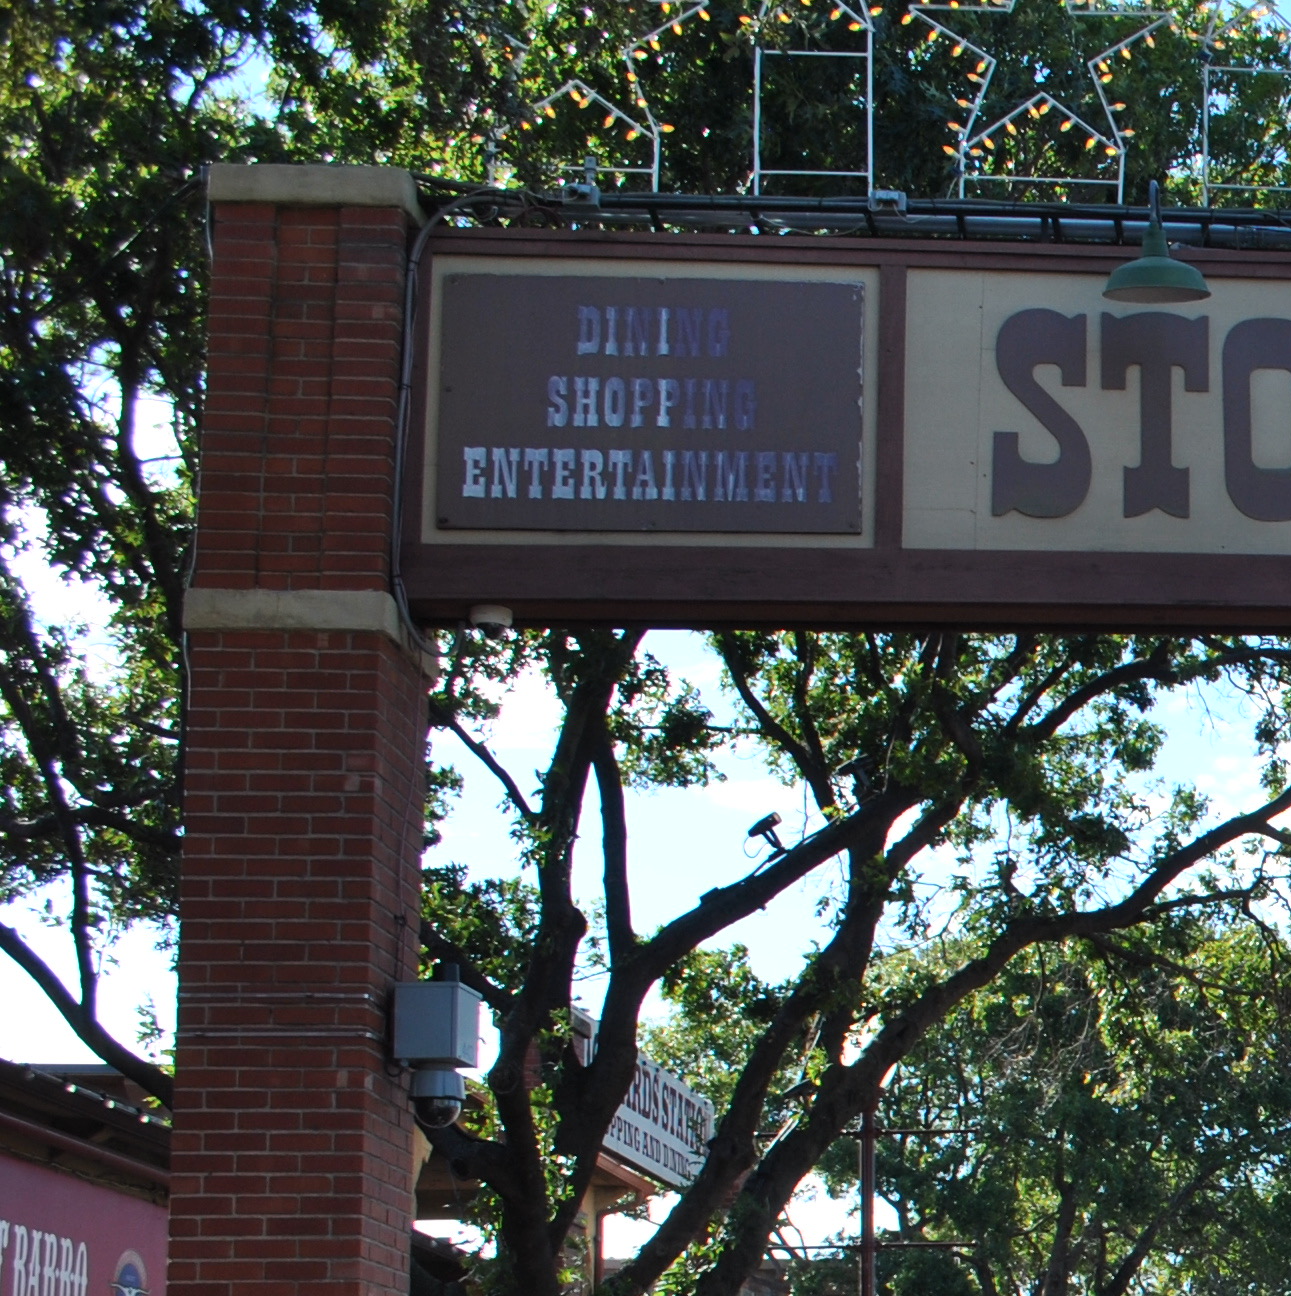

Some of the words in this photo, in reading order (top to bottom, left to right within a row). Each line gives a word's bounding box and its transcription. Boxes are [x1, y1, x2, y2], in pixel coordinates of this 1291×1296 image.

[577, 306, 730, 357] DINING
[547, 376, 757, 429] SHOPPING
[462, 446, 839, 502] ENTERTAINMENT
[642, 1131, 660, 1163] AND
